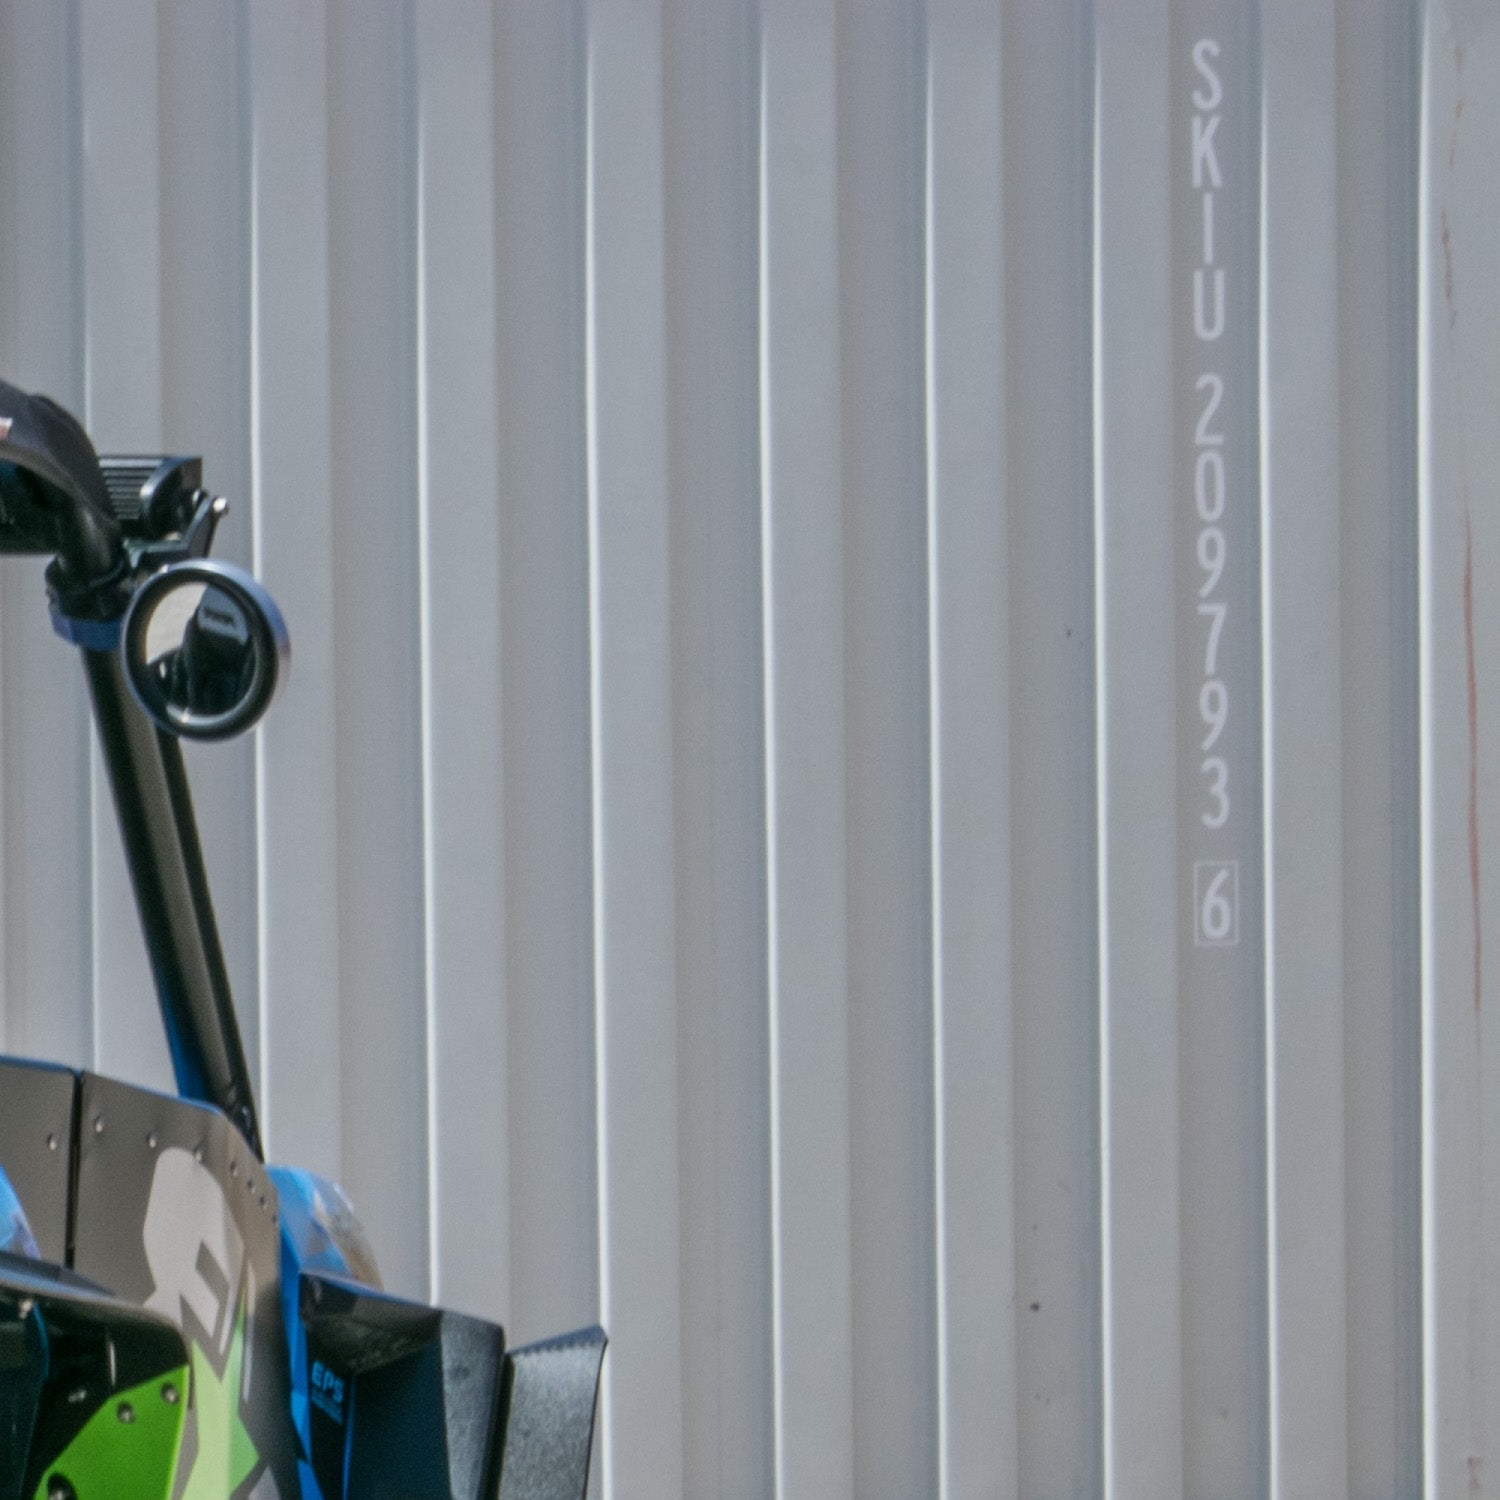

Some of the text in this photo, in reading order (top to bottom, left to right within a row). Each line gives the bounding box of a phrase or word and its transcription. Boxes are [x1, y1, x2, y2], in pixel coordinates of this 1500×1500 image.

[1190, 38, 1232, 940] SKIU 209793 6
[311, 1361, 345, 1403] EPS
